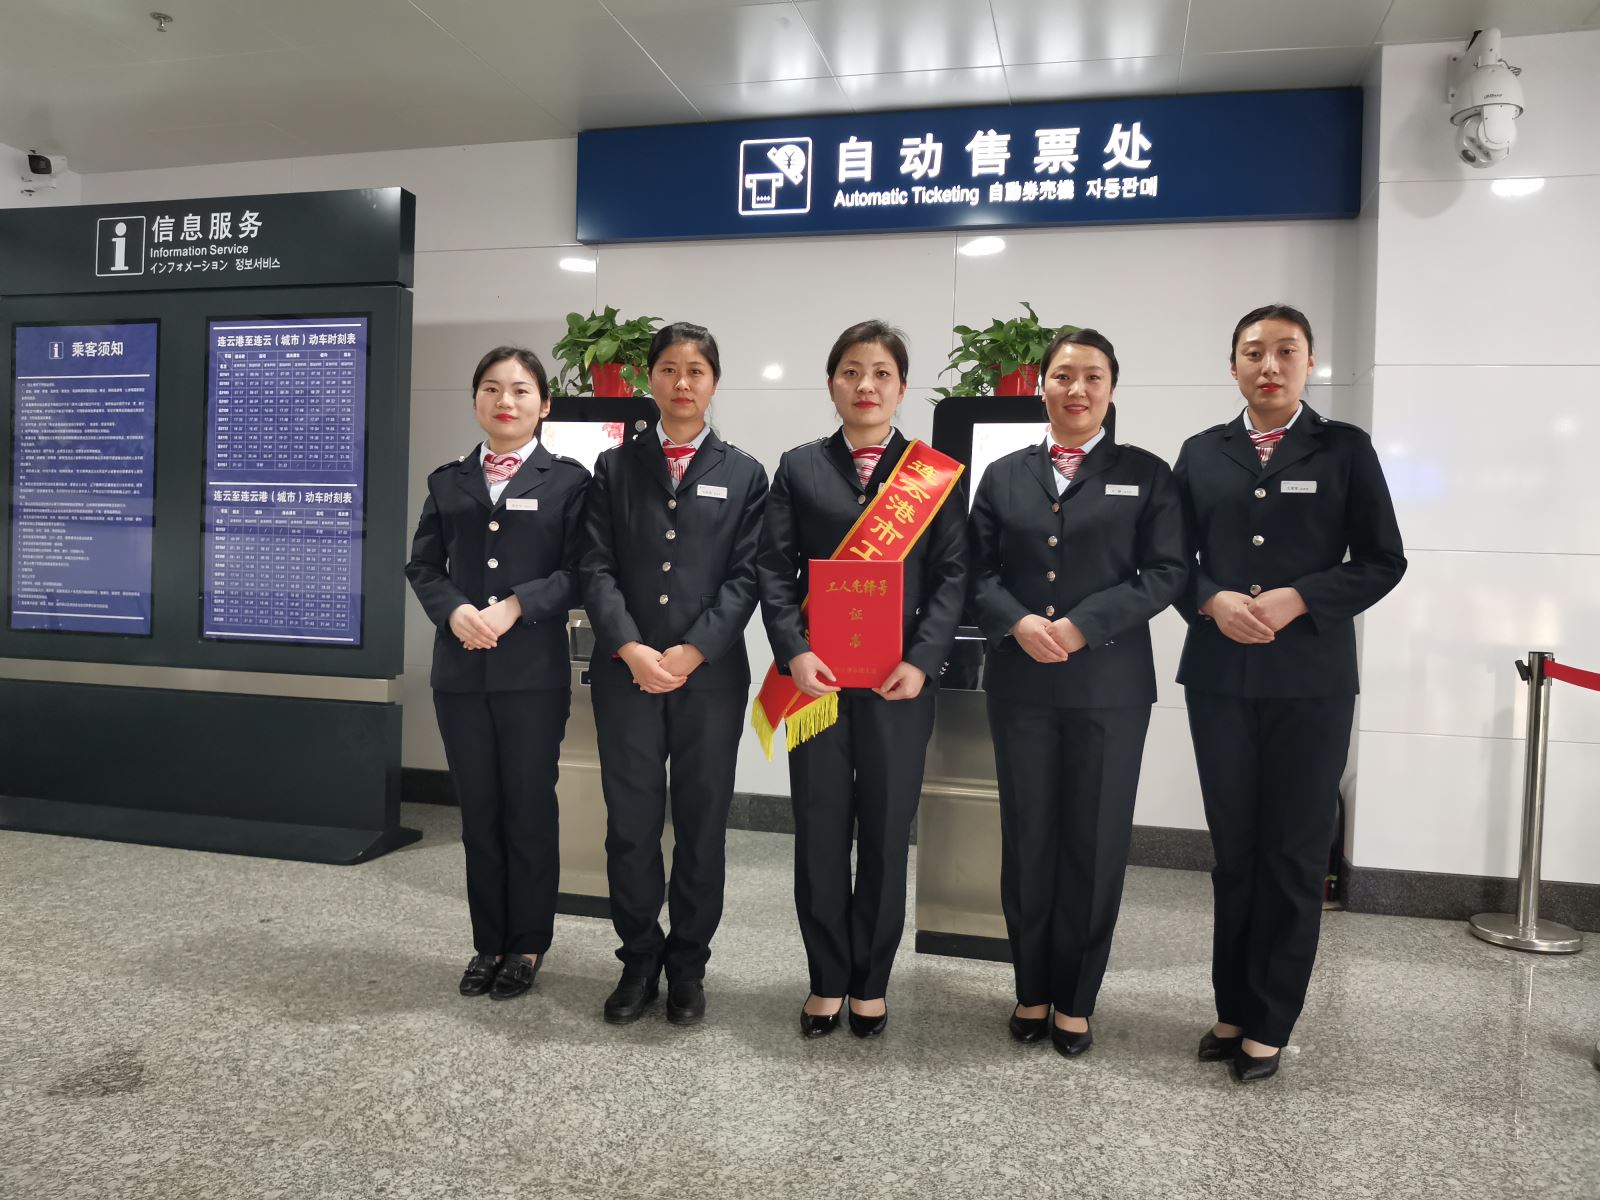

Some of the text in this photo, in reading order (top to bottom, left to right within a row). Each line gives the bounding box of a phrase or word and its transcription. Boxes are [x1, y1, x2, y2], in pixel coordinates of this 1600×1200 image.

[838, 121, 1153, 184] 自动售票处
[833, 187, 908, 207] Automatic
[911, 185, 980, 206] Ticketing
[1085, 175, 1159, 199] 자동판매
[151, 210, 263, 243] 信息服务
[150, 244, 249, 258] Information Service
[150, 257, 281, 274] インフォメーション 정보서비스
[71, 341, 124, 358] 乘客须知
